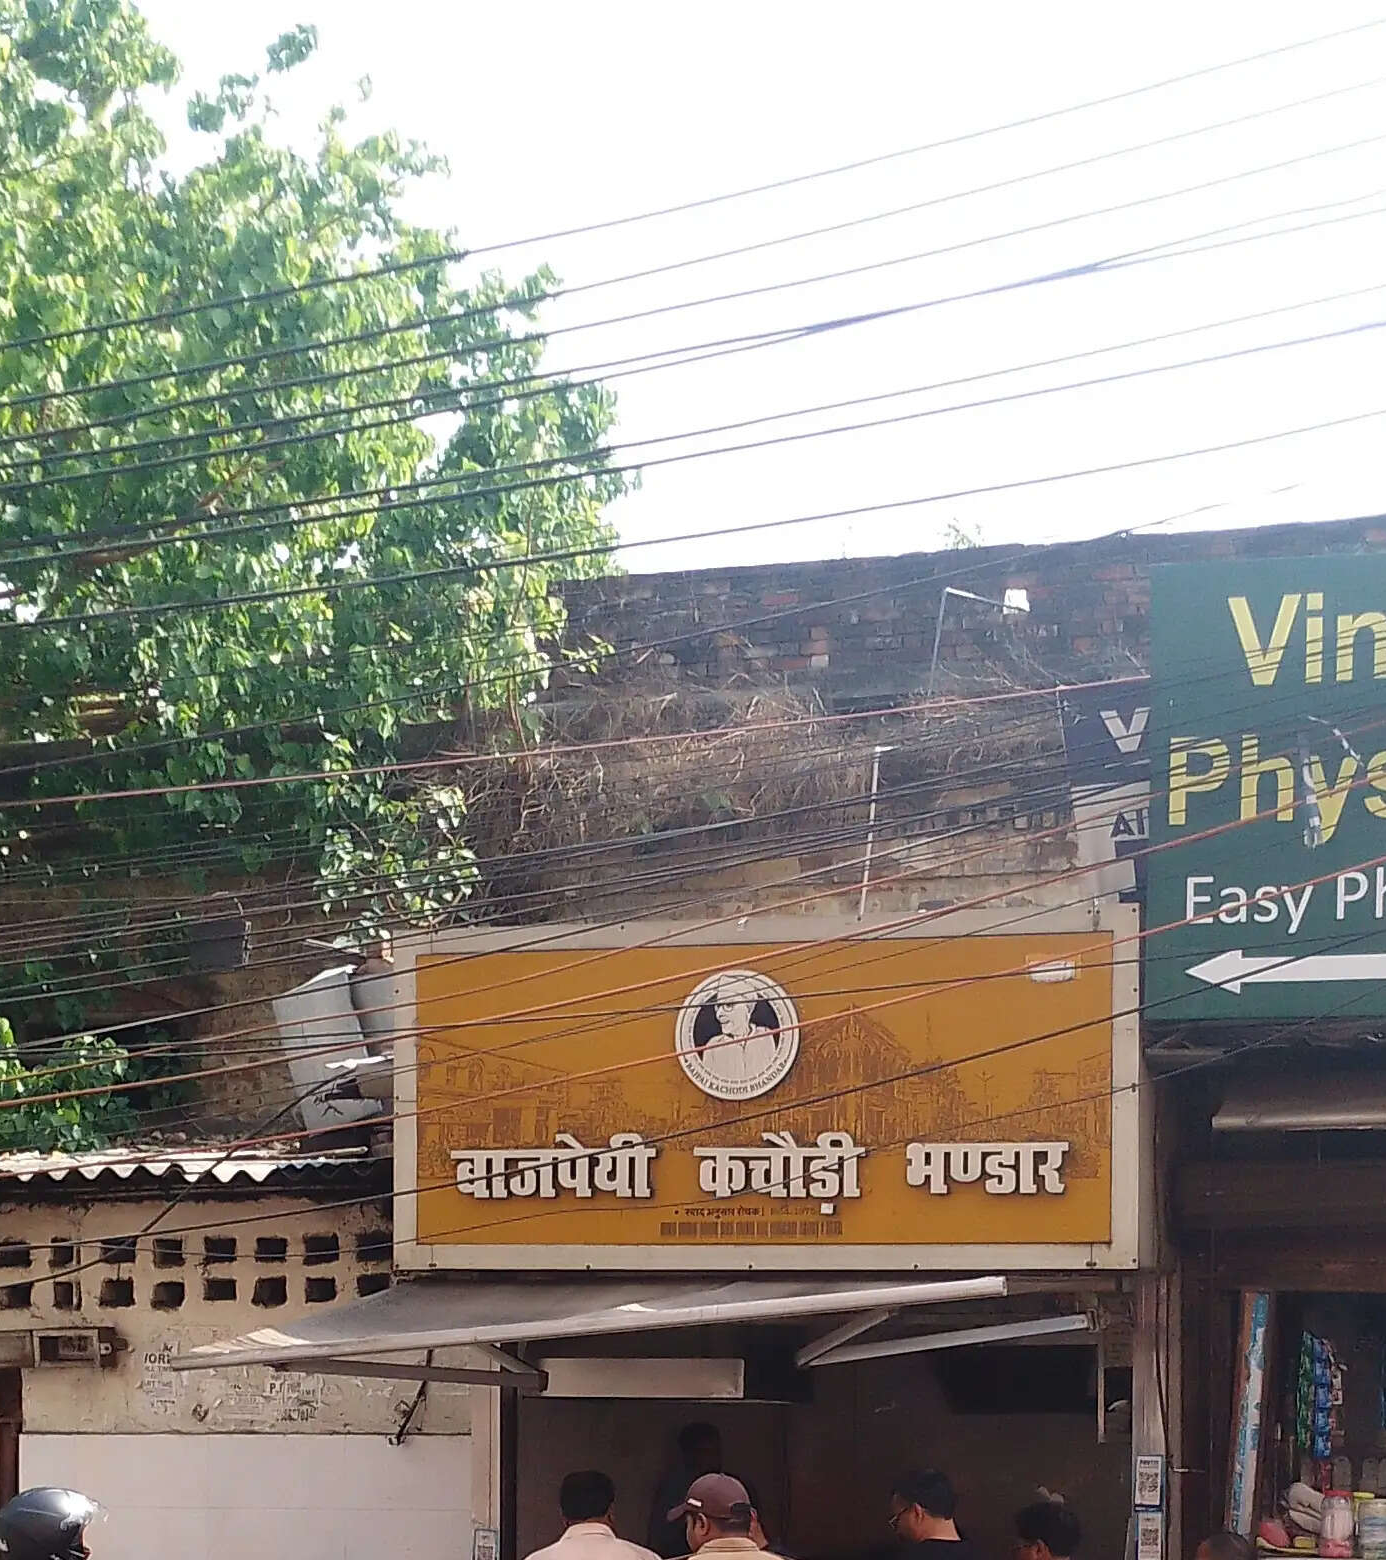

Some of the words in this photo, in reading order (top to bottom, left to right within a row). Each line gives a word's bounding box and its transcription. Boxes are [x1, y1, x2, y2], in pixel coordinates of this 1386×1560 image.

[1185, 875, 1315, 935] Easy
[451, 1131, 658, 1200] बाजपेयी
[905, 1140, 1071, 1196] भण्डार
